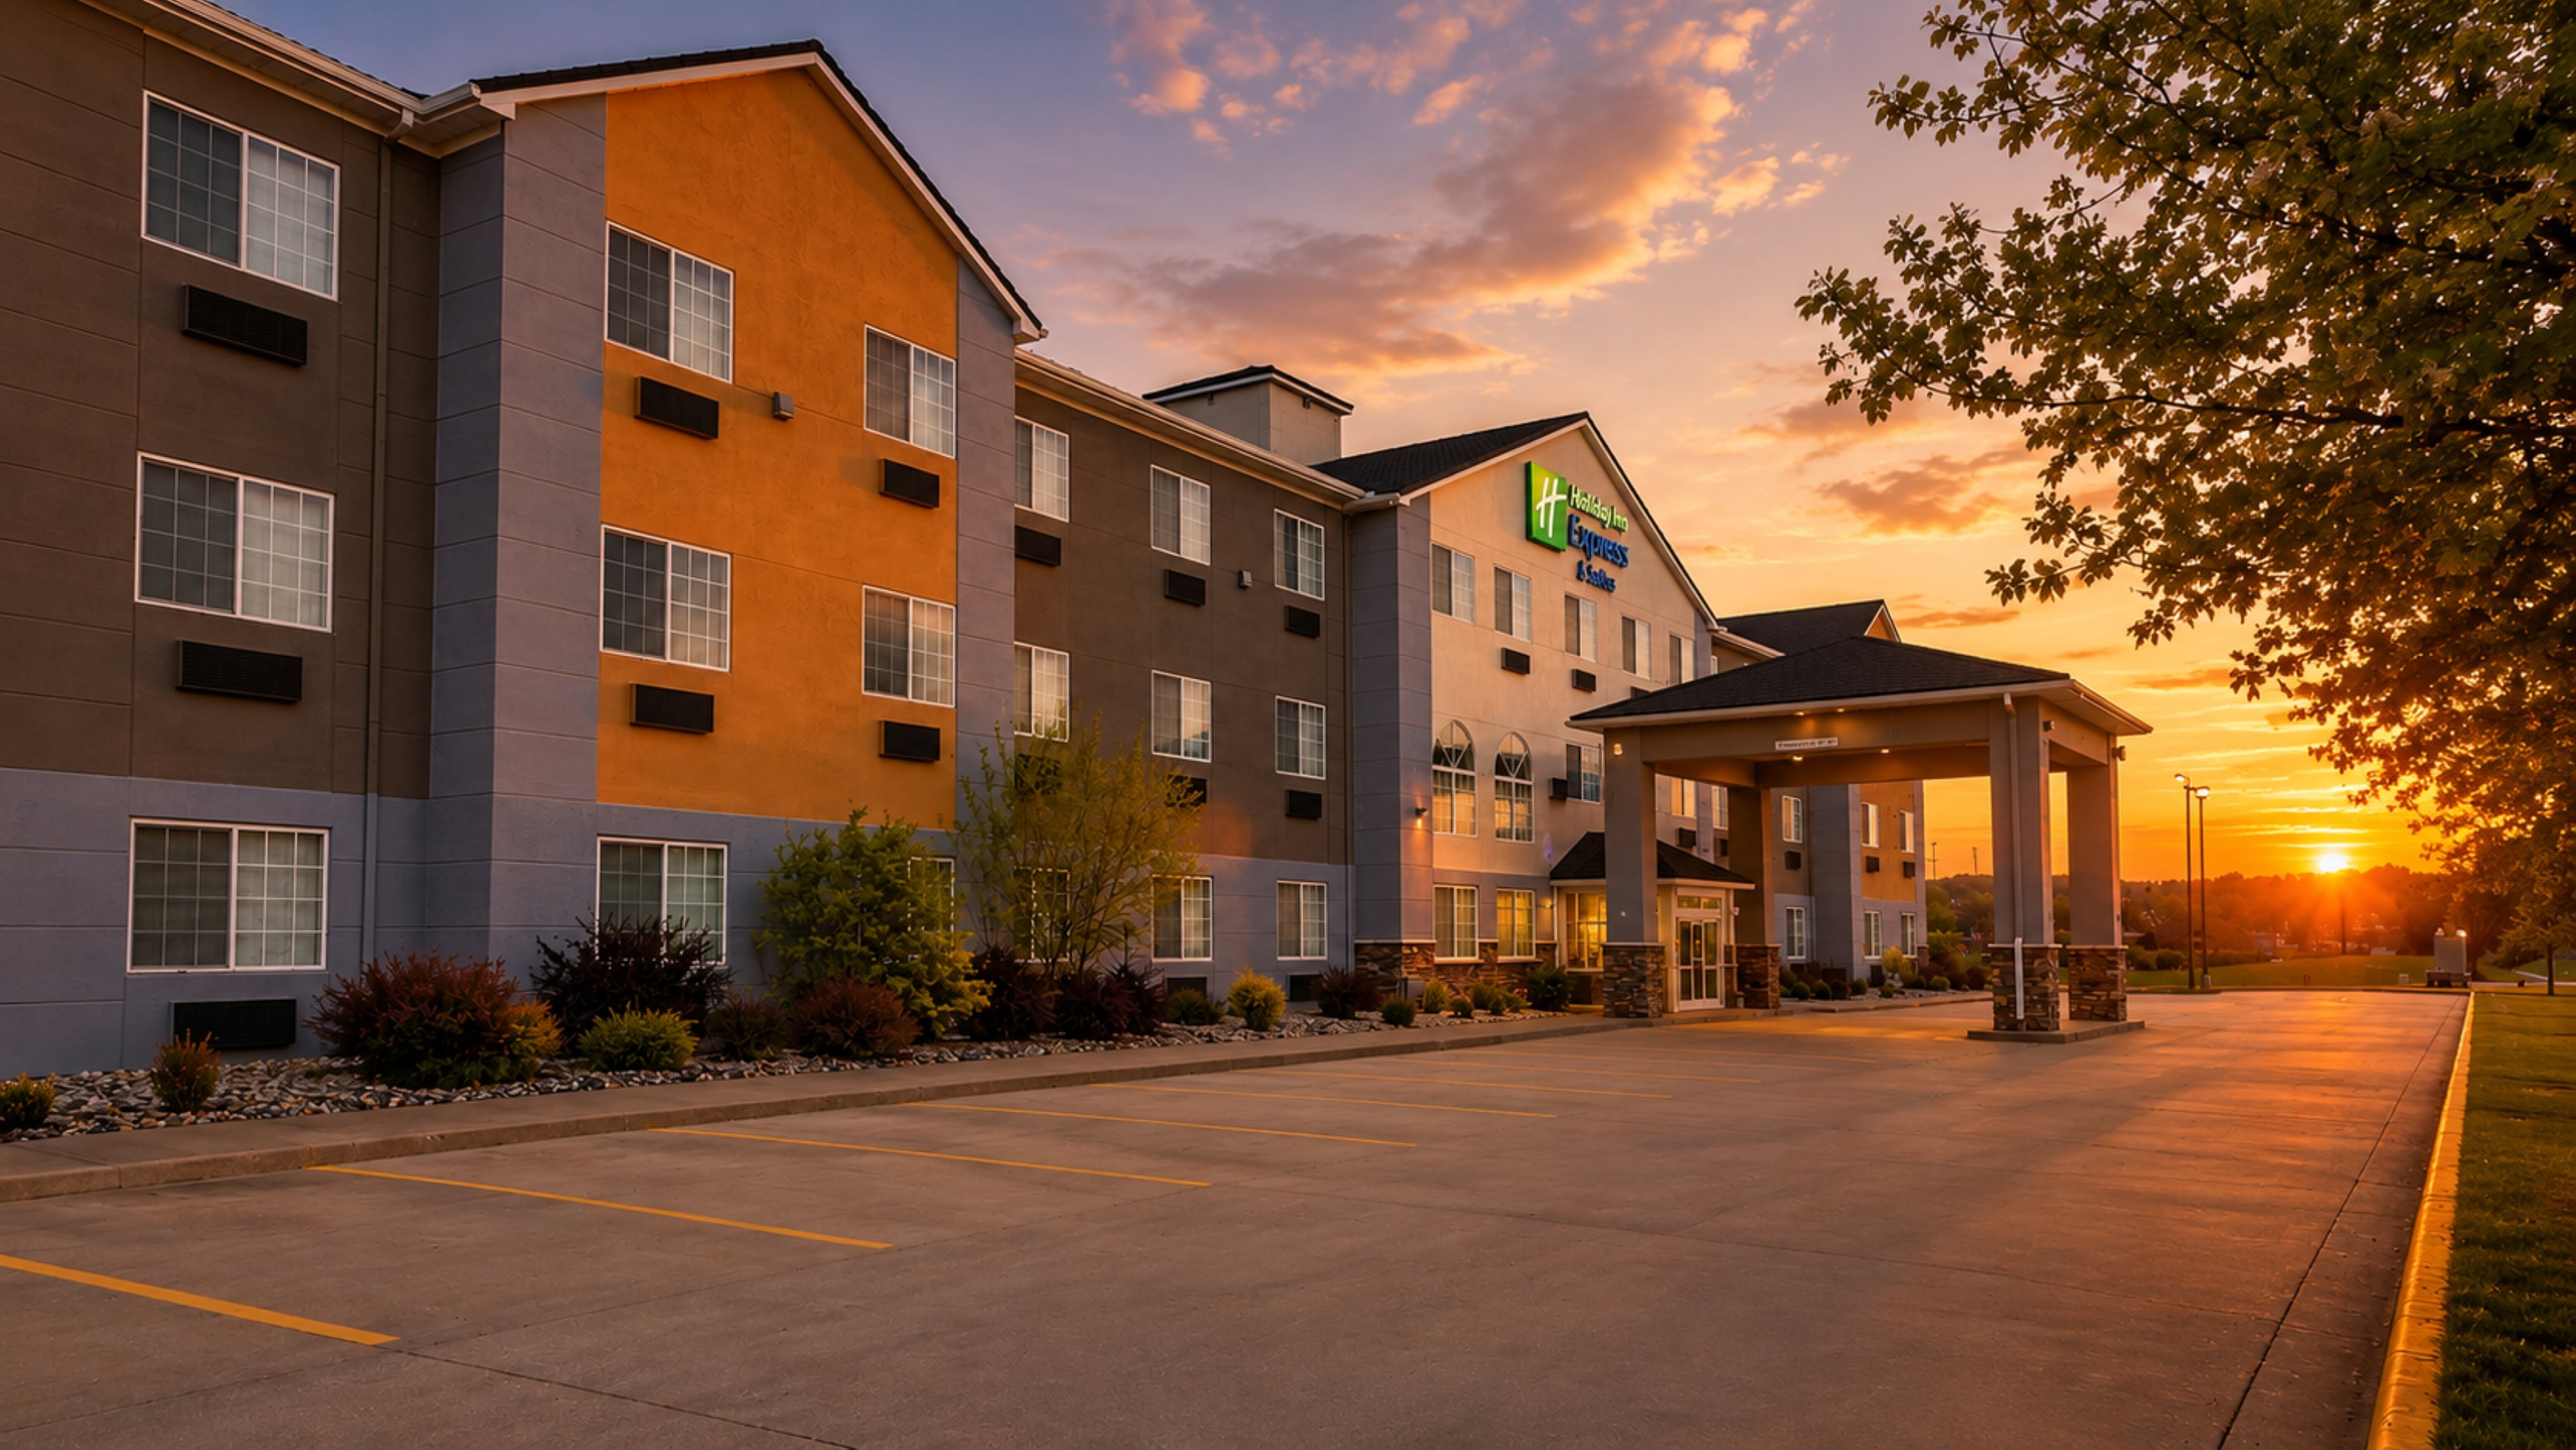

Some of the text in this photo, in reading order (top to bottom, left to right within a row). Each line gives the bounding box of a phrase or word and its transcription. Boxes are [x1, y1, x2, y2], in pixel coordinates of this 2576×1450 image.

[1568, 484, 1628, 533] Holiday Inn
[1568, 514, 1628, 567] Express
